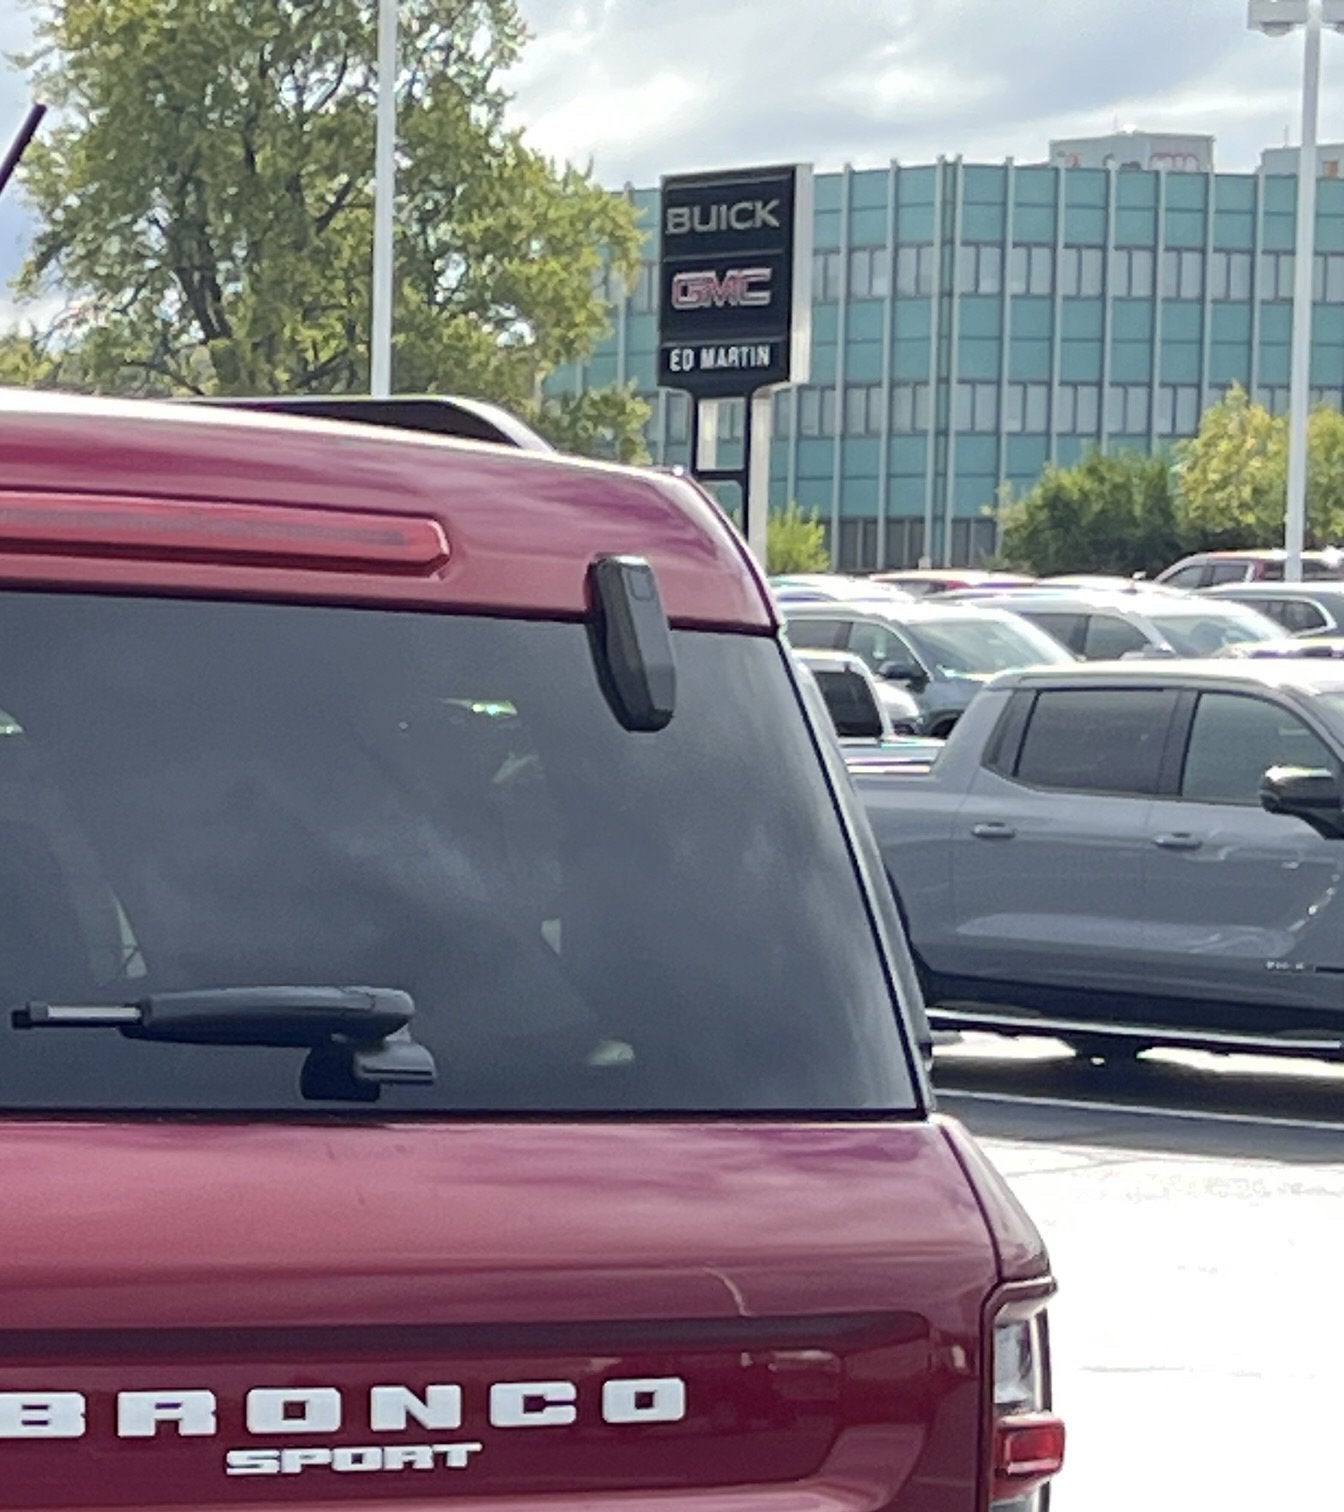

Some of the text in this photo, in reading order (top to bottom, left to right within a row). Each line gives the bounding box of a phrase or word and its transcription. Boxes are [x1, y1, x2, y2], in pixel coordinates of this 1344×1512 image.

[666, 200, 780, 235] BUICK
[672, 267, 772, 310] GMC
[669, 345, 771, 371] ED MARTIN
[226, 1441, 482, 1475] SPORT
